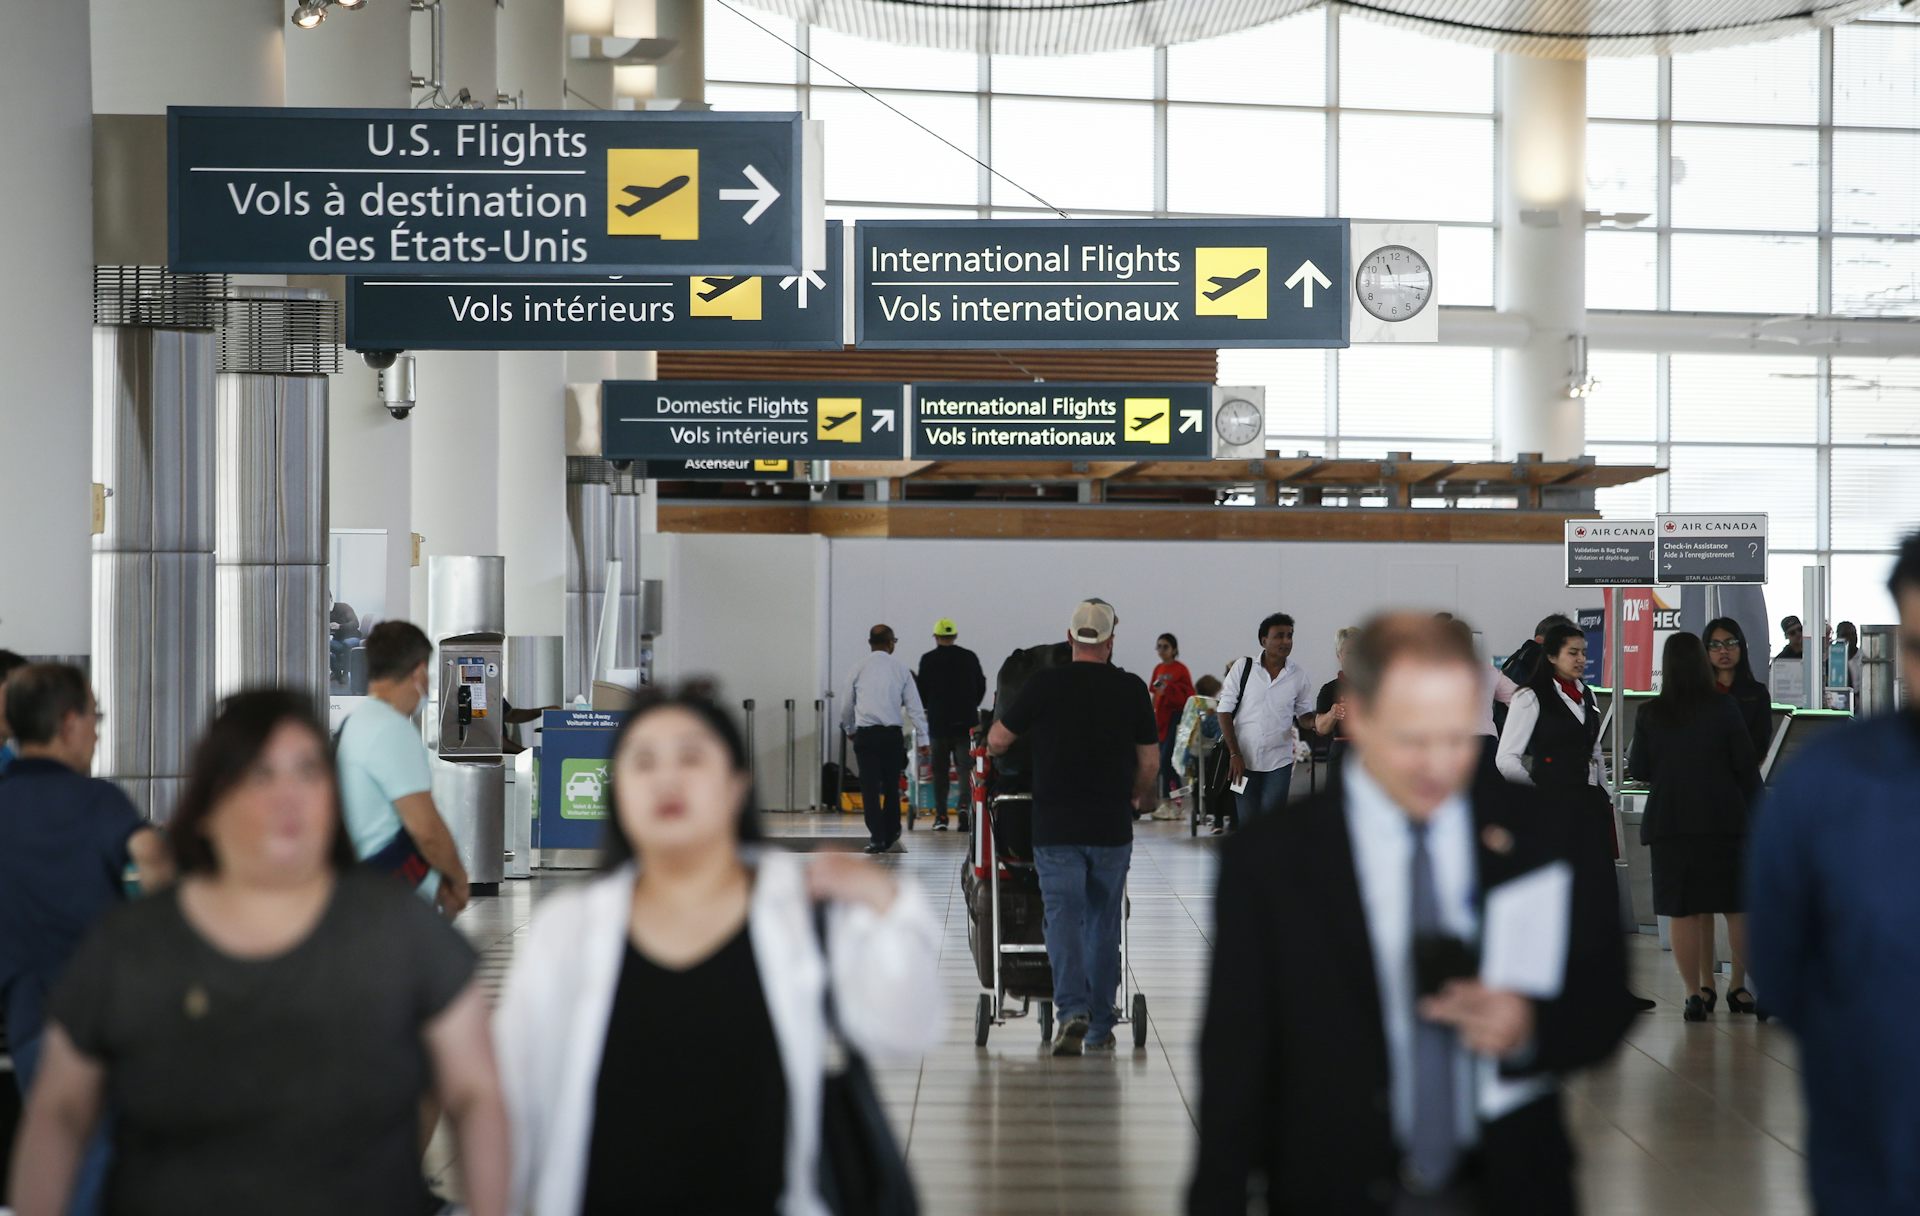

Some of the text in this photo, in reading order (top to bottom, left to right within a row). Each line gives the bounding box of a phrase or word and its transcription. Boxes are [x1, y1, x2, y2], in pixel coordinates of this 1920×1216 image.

[369, 123, 587, 166] U.S. Flights
[228, 181, 586, 217] Vols à destination
[309, 221, 587, 262] des États-Unis
[873, 245, 1180, 279] International Flights
[448, 295, 674, 322] Vols intérieurs
[879, 294, 1179, 321] Vols internationaux
[657, 396, 808, 418] Domestic Flights
[921, 397, 1116, 419] International Flights
[670, 426, 808, 444] Vols intérieurs
[926, 427, 1115, 445] Vols internationaux
[685, 459, 750, 469] Ascenseur
[1623, 599, 1649, 621] nx AIR
[1653, 612, 1680, 628] HEC
